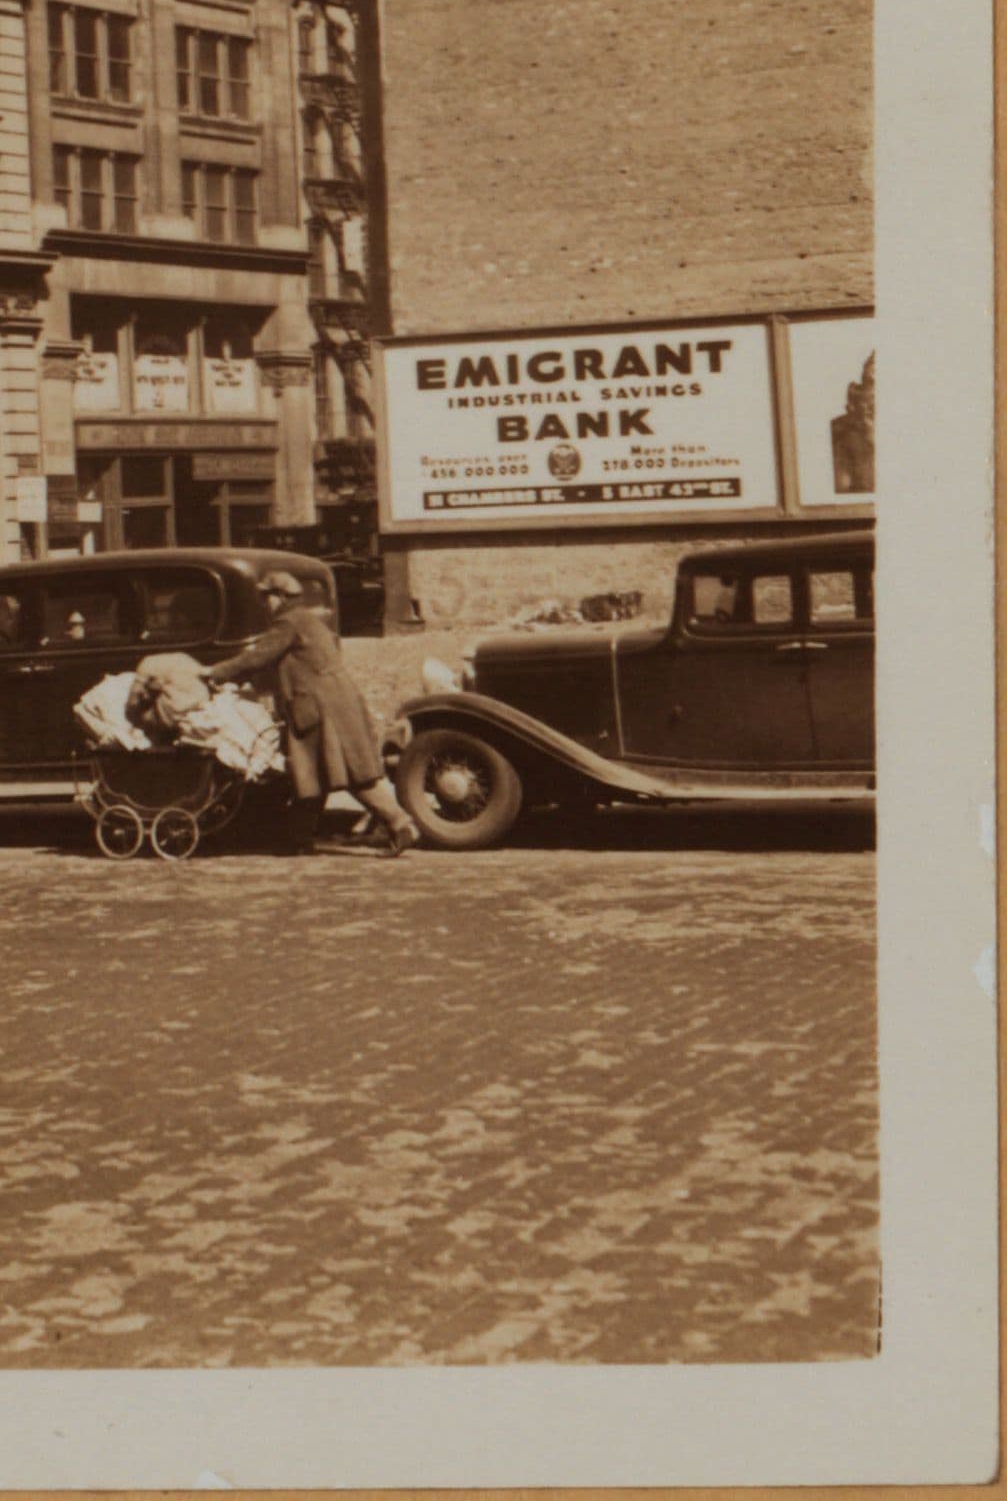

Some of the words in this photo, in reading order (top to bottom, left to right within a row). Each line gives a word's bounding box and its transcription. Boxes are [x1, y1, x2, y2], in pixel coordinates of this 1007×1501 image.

[416, 340, 732, 390] EMIGRANT
[448, 392, 581, 409] INDUSTRIAL
[601, 382, 703, 401] SAVINGS
[497, 408, 655, 443] BANK
[630, 444, 667, 458] More
[671, 442, 709, 456] than
[670, 455, 741, 470] Depositors
[618, 483, 665, 499] EAST
